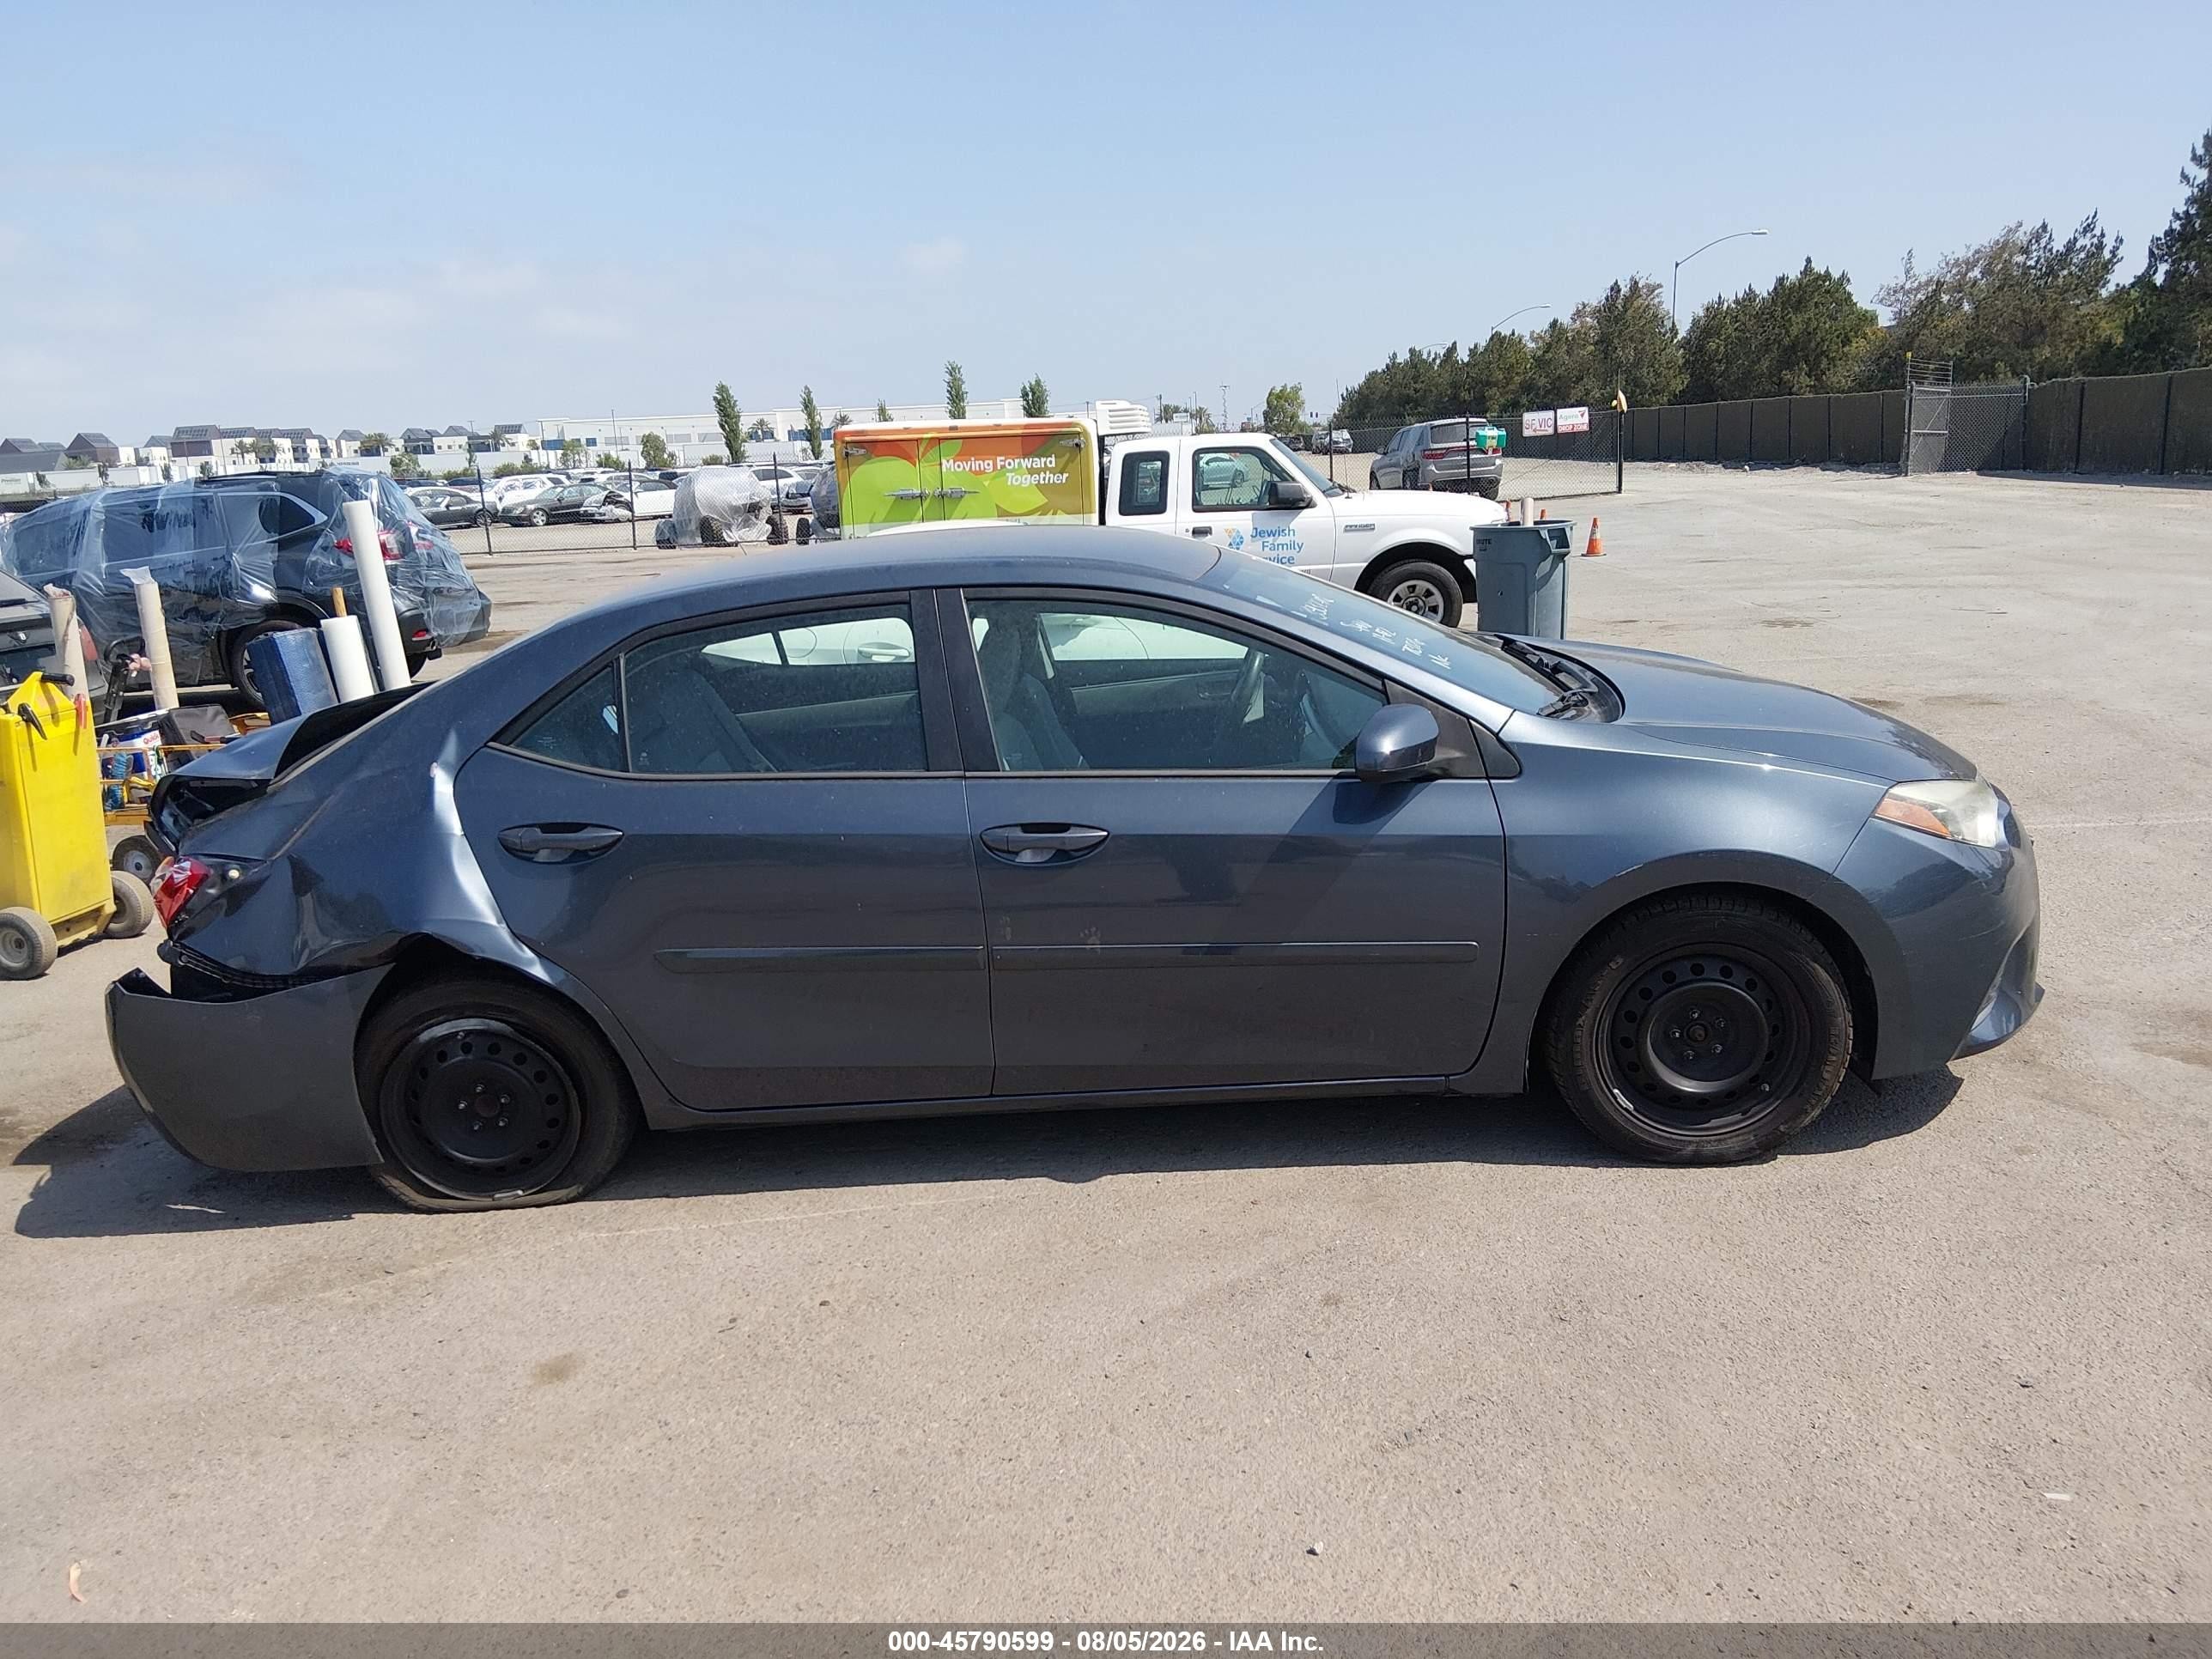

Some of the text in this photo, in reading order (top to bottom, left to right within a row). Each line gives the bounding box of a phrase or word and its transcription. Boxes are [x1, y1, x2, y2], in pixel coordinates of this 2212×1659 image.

[1538, 417, 1553, 428] VIC
[942, 454, 1055, 472] Moving Forward
[1006, 471, 1068, 486] Together
[1250, 526, 1296, 538] Jewish
[1261, 540, 1304, 553] Family
[1263, 554, 1295, 564] vice
